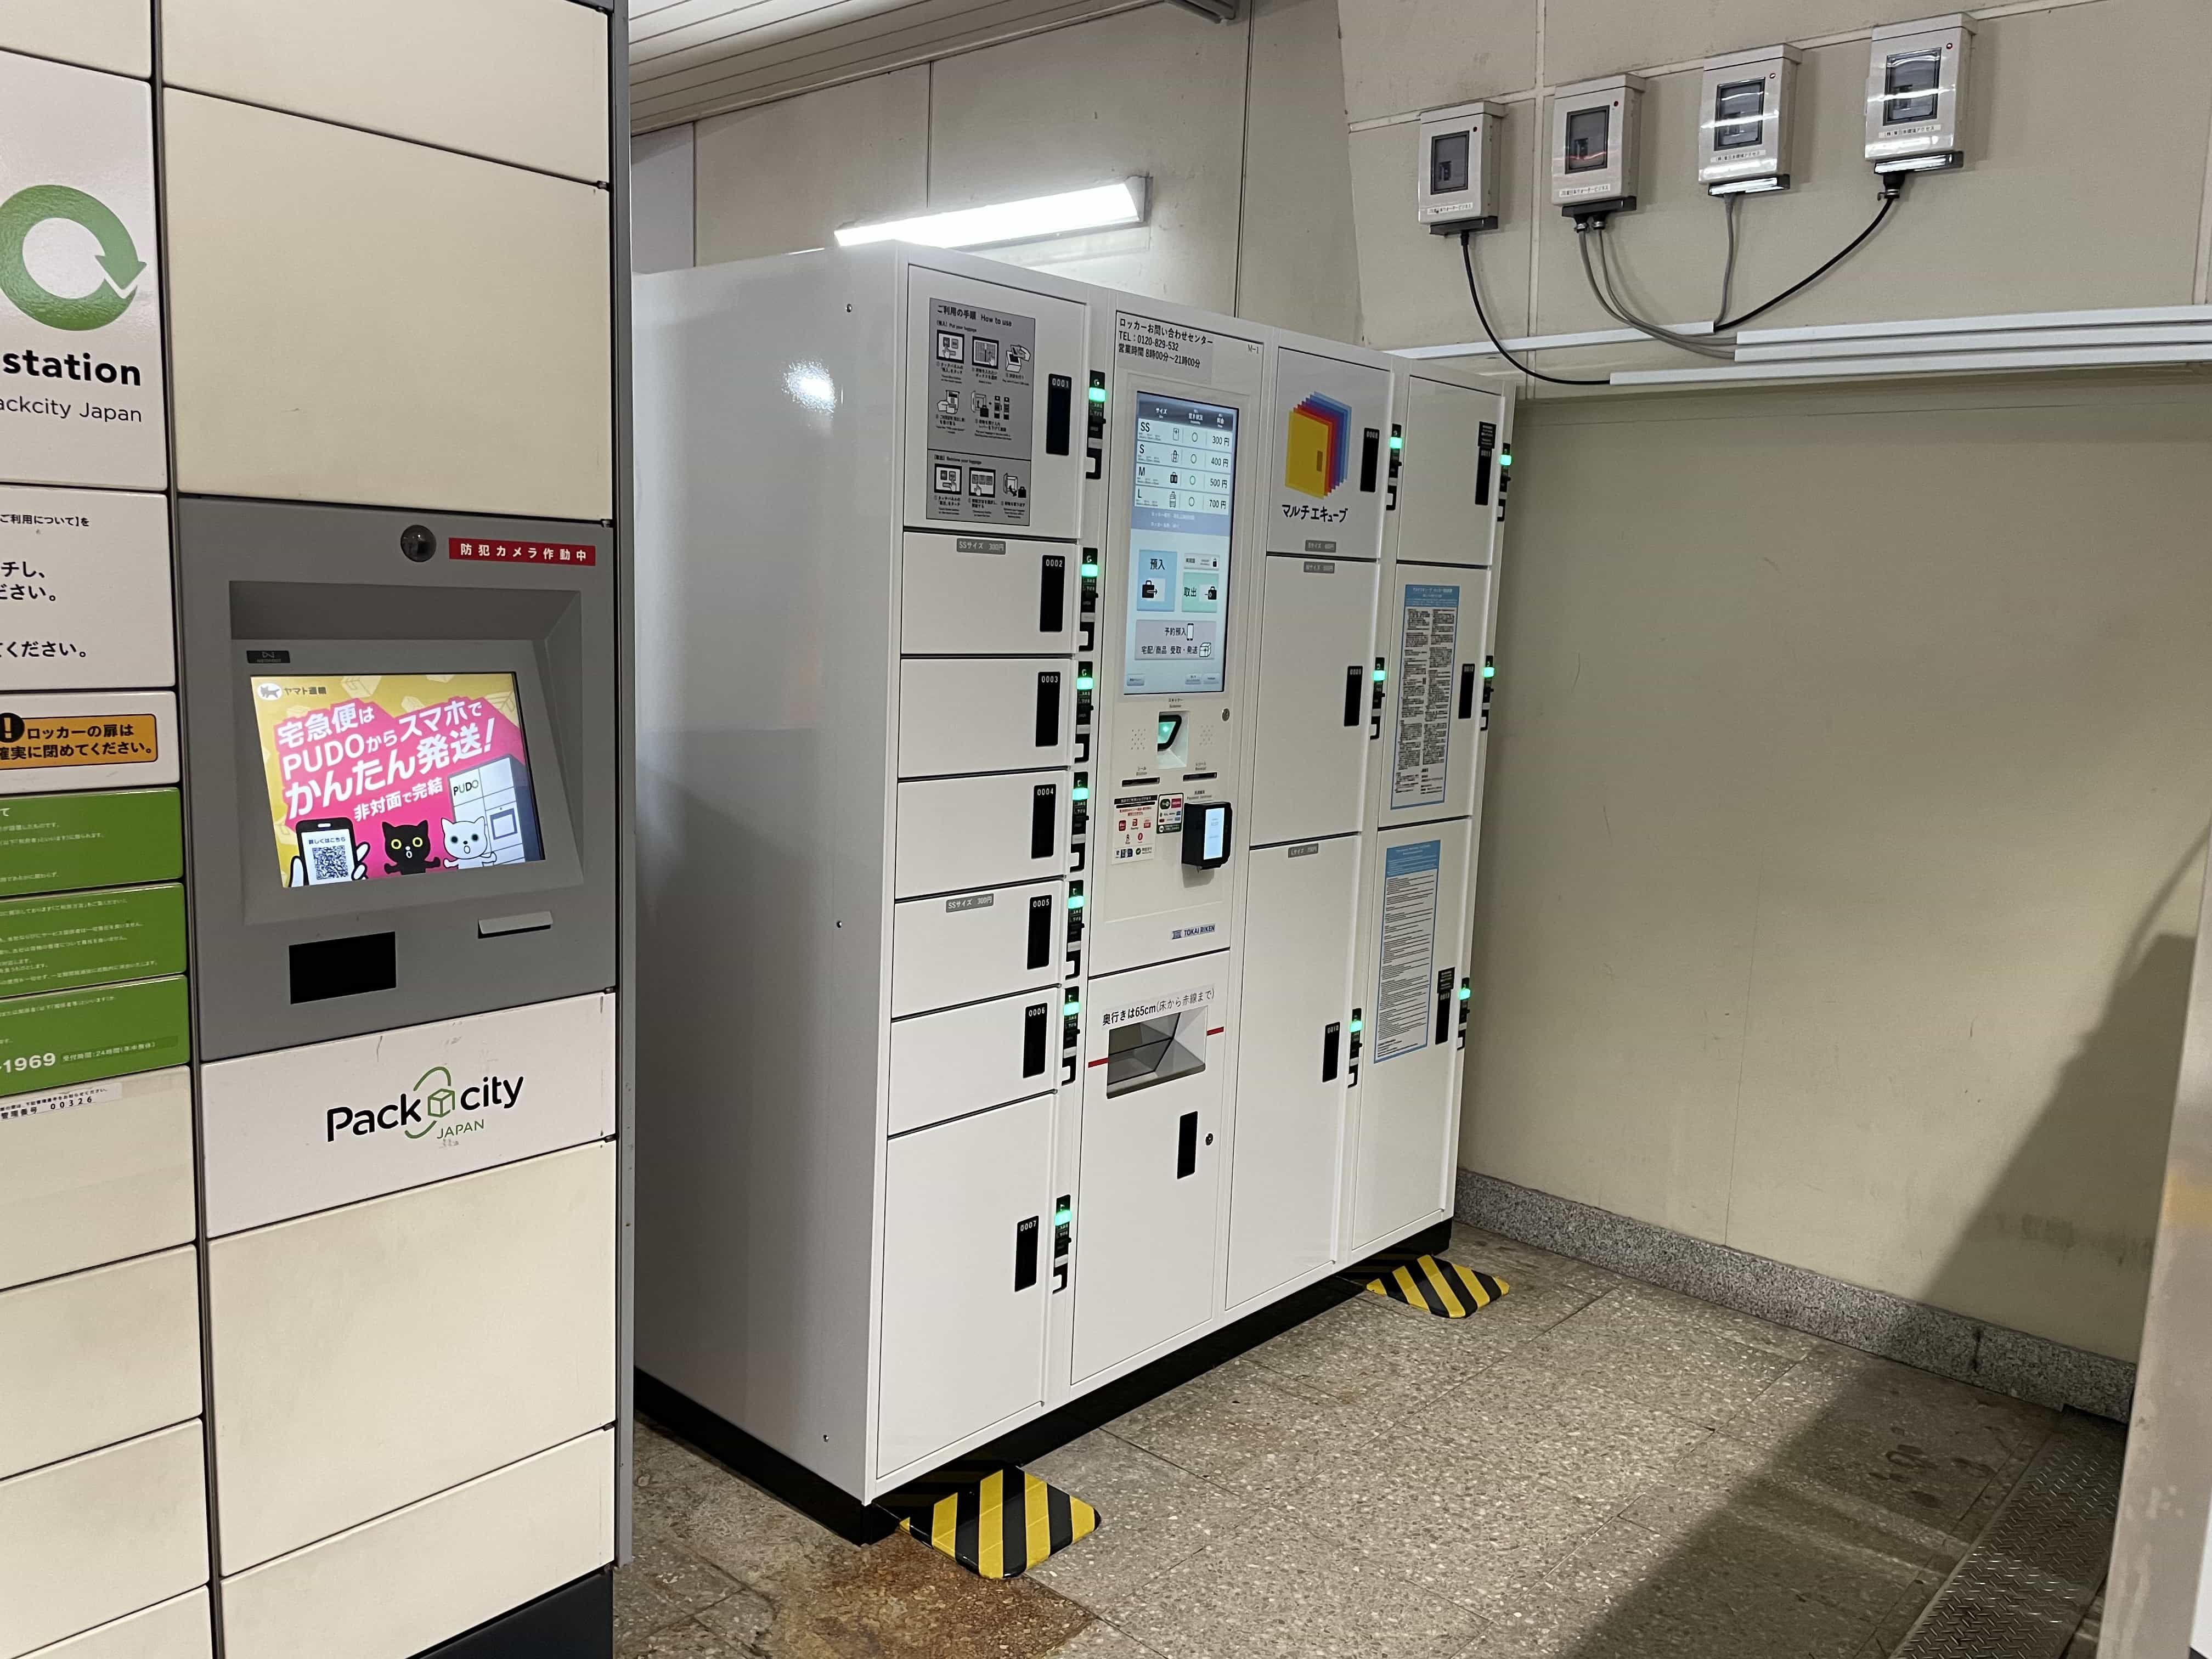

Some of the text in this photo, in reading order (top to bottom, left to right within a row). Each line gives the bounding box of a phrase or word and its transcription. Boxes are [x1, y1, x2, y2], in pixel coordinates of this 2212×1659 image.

[937, 305, 977, 320] ご利用の手順
[980, 314, 993, 323] How
[1120, 318, 1214, 345] ロッカーお問い合わせセンター
[1119, 343, 1144, 357] 営業時間
[2, 349, 142, 386] station
[1052, 377, 1069, 388] 0001
[79, 402, 142, 422] Japan
[1141, 422, 1150, 432] SS
[1139, 444, 1145, 454] S
[1138, 467, 1146, 476] M
[1137, 489, 1142, 498] L
[1282, 504, 1348, 522] マルチエキューブ
[0, 514, 90, 527] ご利用について】を
[460, 543, 586, 561] 防犯カメラ作動中
[1046, 558, 1063, 567] 0002
[1149, 558, 1165, 570] 預入
[1, 561, 45, 578] チし、
[1183, 587, 1197, 597] 取出
[0, 641, 86, 658] ください。
[1041, 675, 1058, 684] 0003
[27, 724, 134, 740] ロッカーの扉は
[278, 702, 375, 749] 宅急便は
[281, 700, 483, 781] PUDOからスマホで
[453, 779, 479, 796] PUDO
[1037, 787, 1054, 795] 0004
[353, 777, 444, 822] 非対面で完結
[947, 898, 973, 909] SSサイズ
[1032, 898, 1049, 908] 0005
[1183, 924, 1215, 937] TOKAI RIKEN
[1029, 1007, 1045, 1017] 0006
[327, 1076, 524, 1142] Pack city
[437, 1119, 484, 1139] JAPAN
[1020, 1220, 1036, 1232] 0007
